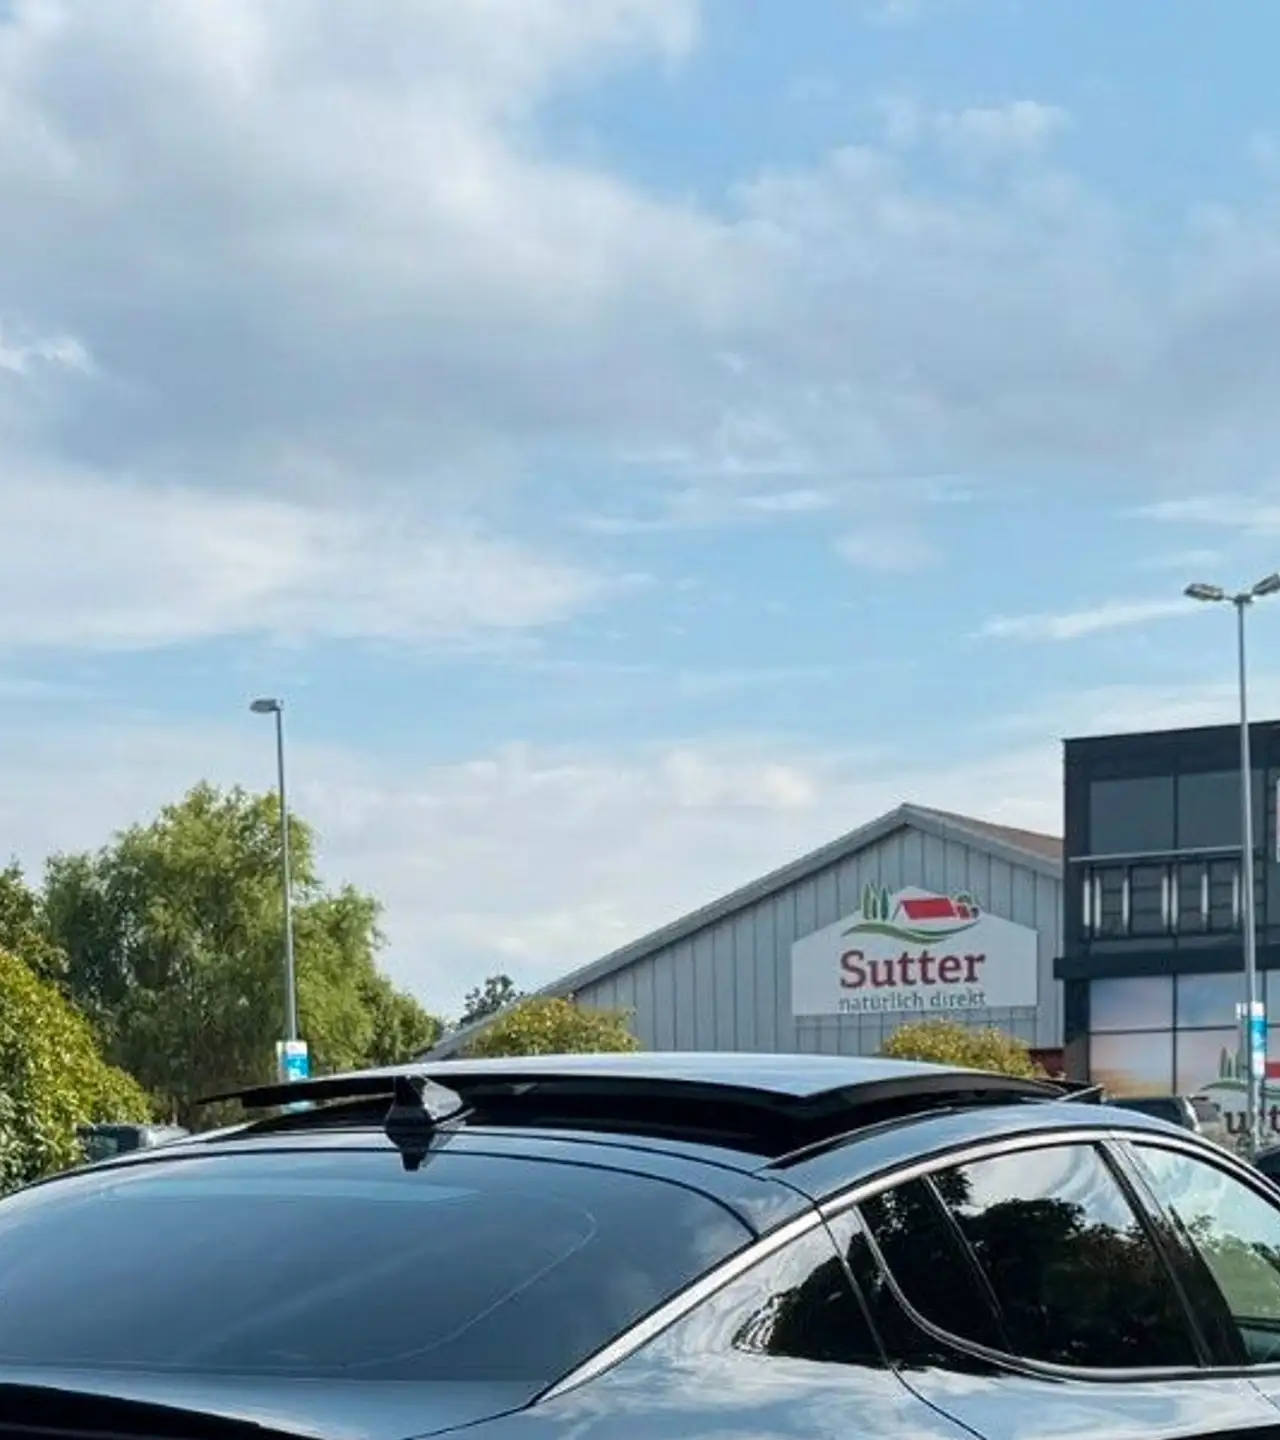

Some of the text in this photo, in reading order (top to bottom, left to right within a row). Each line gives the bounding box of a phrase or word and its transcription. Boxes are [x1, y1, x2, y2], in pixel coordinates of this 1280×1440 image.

[839, 949, 986, 988] Sutter
[839, 988, 986, 1012] natürlich direkt
